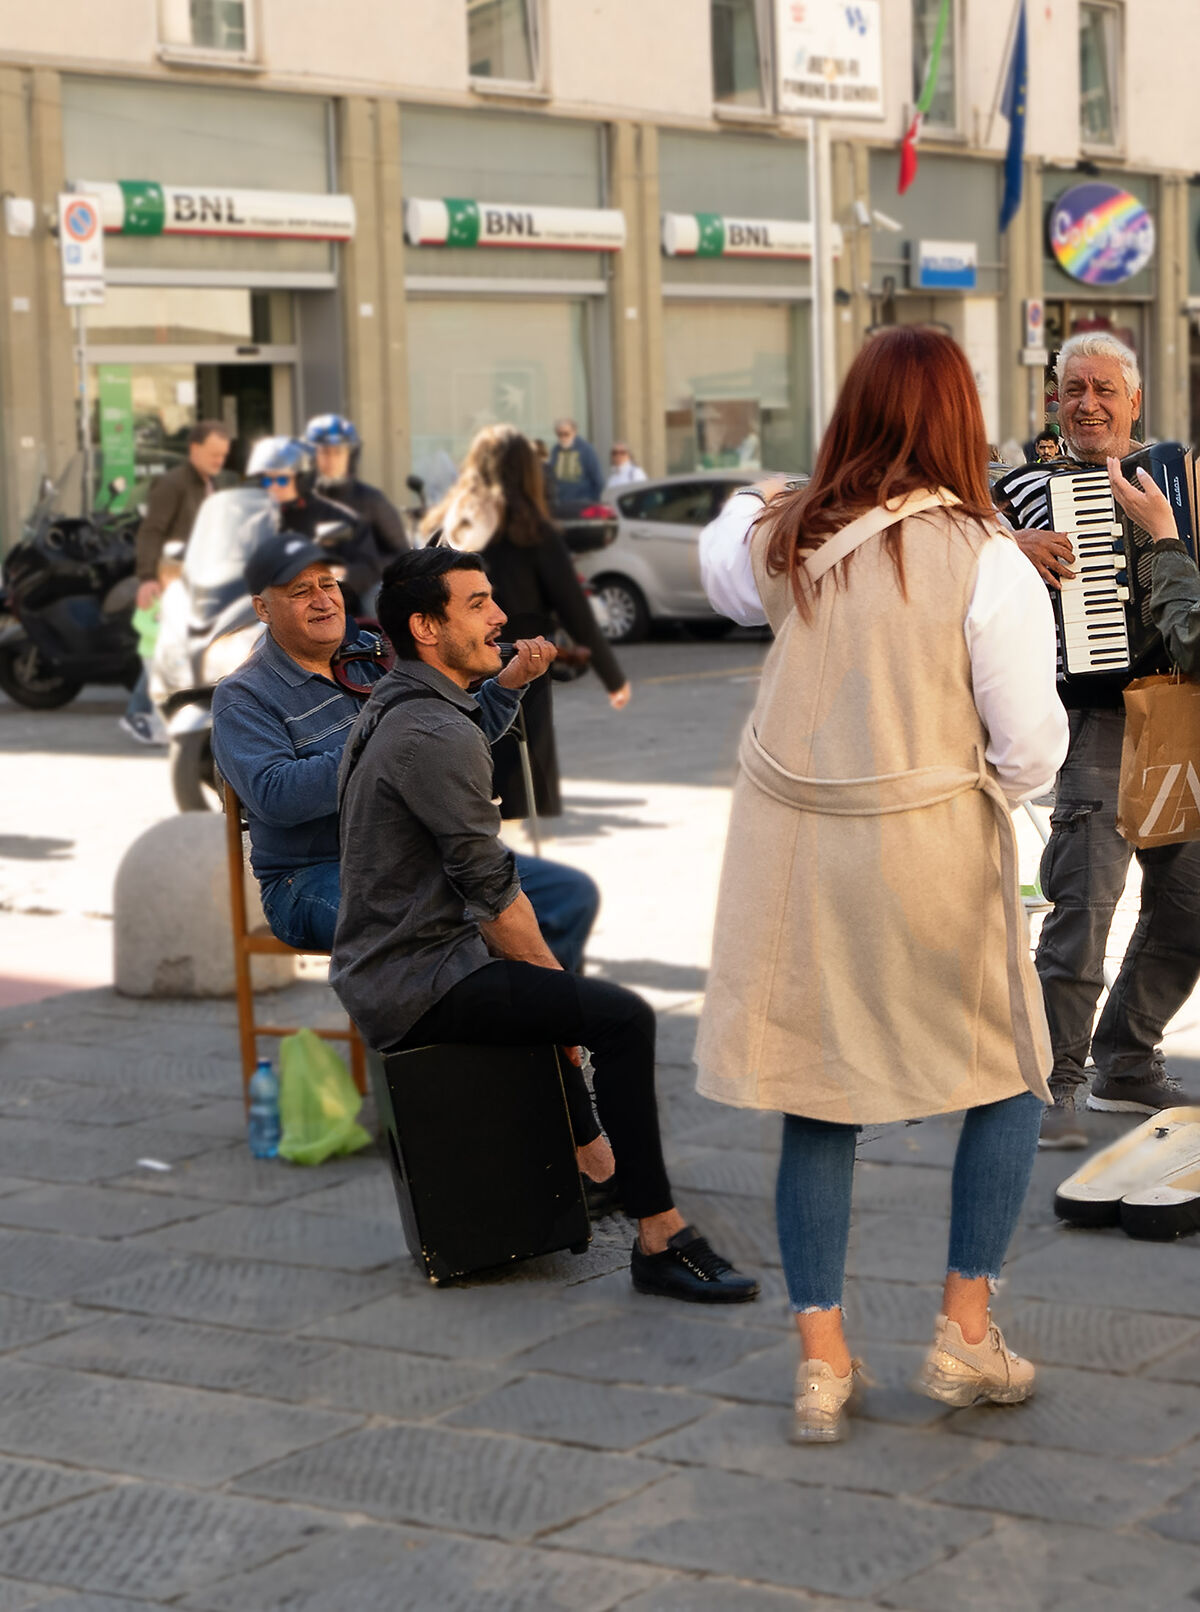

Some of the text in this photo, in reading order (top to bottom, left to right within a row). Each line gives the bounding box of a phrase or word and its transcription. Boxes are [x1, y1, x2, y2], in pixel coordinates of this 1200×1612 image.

[172, 193, 246, 224] BNL
[485, 210, 541, 237] BNL
[729, 223, 774, 248] BNL
